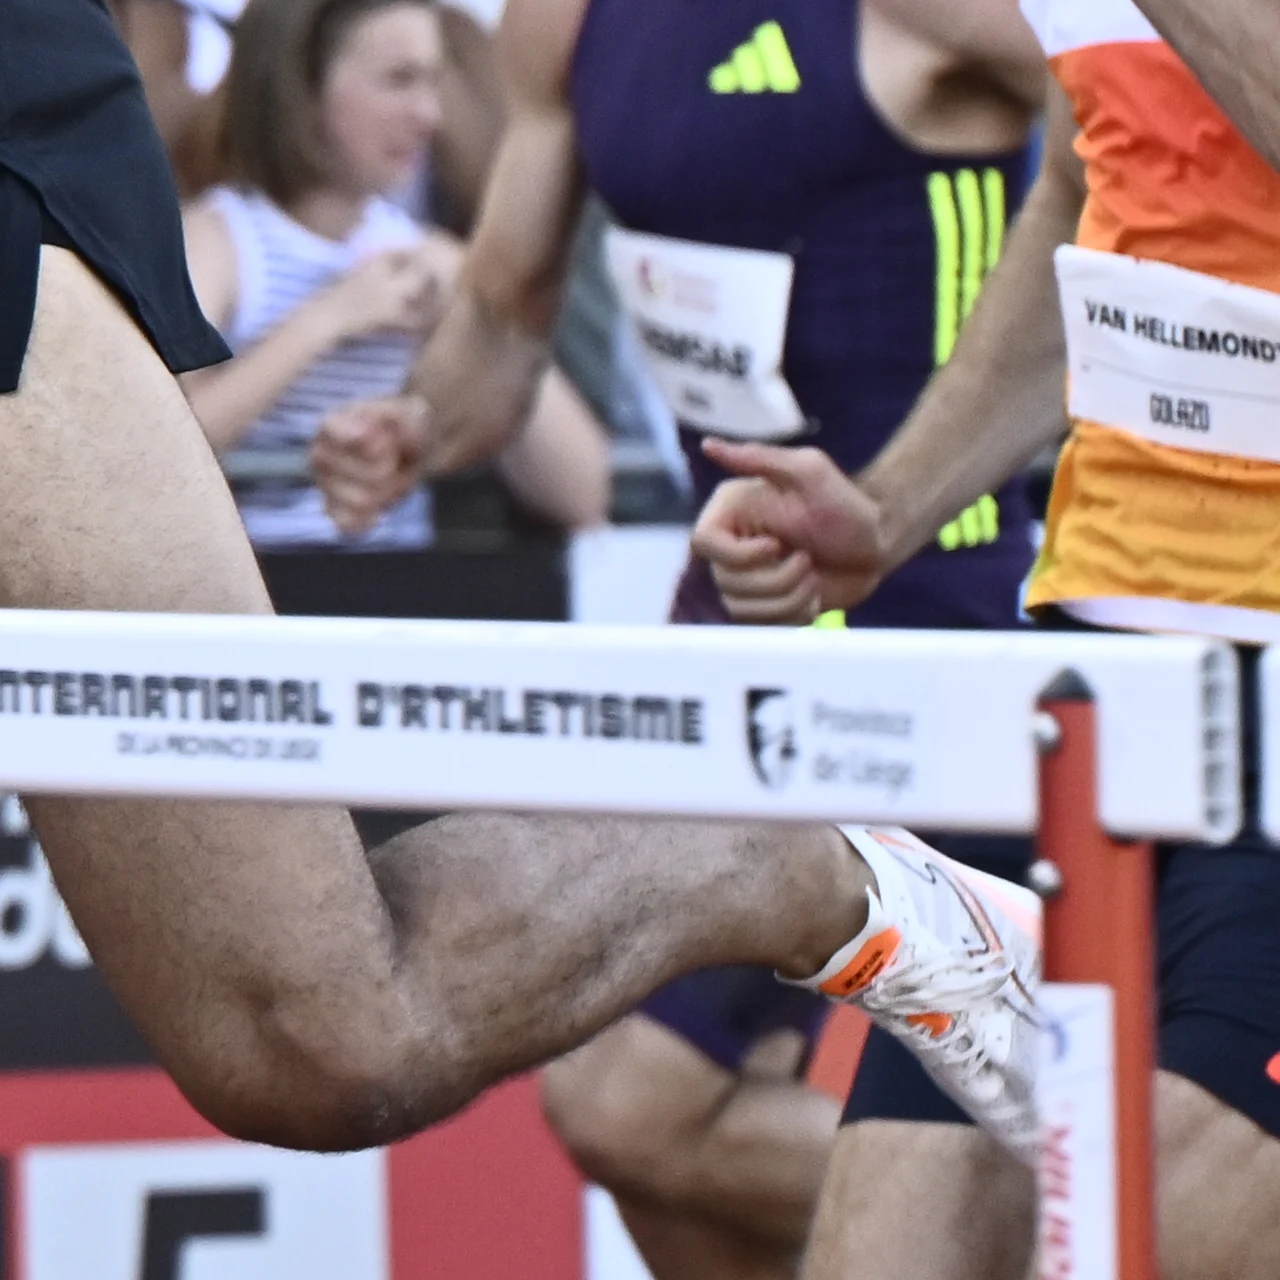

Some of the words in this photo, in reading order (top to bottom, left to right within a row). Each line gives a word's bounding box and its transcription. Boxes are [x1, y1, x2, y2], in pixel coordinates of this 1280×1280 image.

[1084, 298, 1127, 332] VAN
[1149, 392, 1210, 433] GOLAZO
[356, 681, 703, 744] D'ATHLETISME
